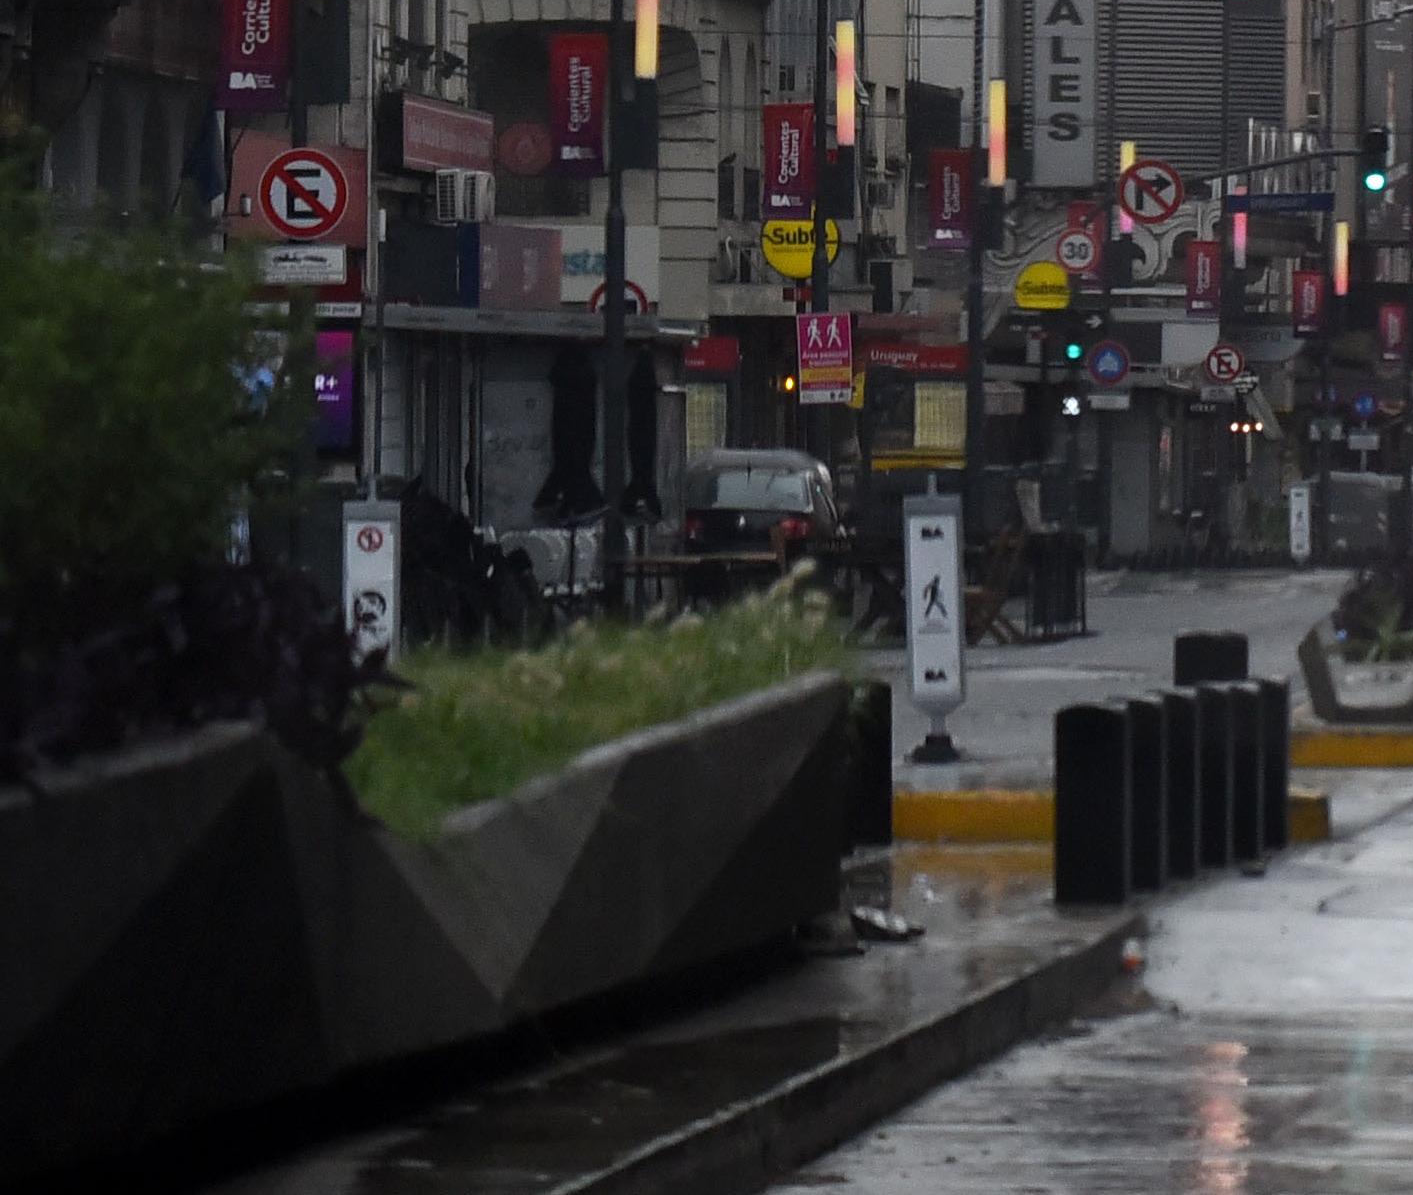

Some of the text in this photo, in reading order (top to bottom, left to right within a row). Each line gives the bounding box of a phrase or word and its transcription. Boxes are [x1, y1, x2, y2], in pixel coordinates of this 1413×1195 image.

[567, 56, 581, 133] Corrientes
[578, 64, 593, 124] Cultural
[778, 120, 790, 185] Corrientes
[788, 128, 800, 178] Cultural
[772, 227, 828, 246] Subt
[1064, 241, 1089, 260] 30
[869, 349, 920, 363] Uruguay
